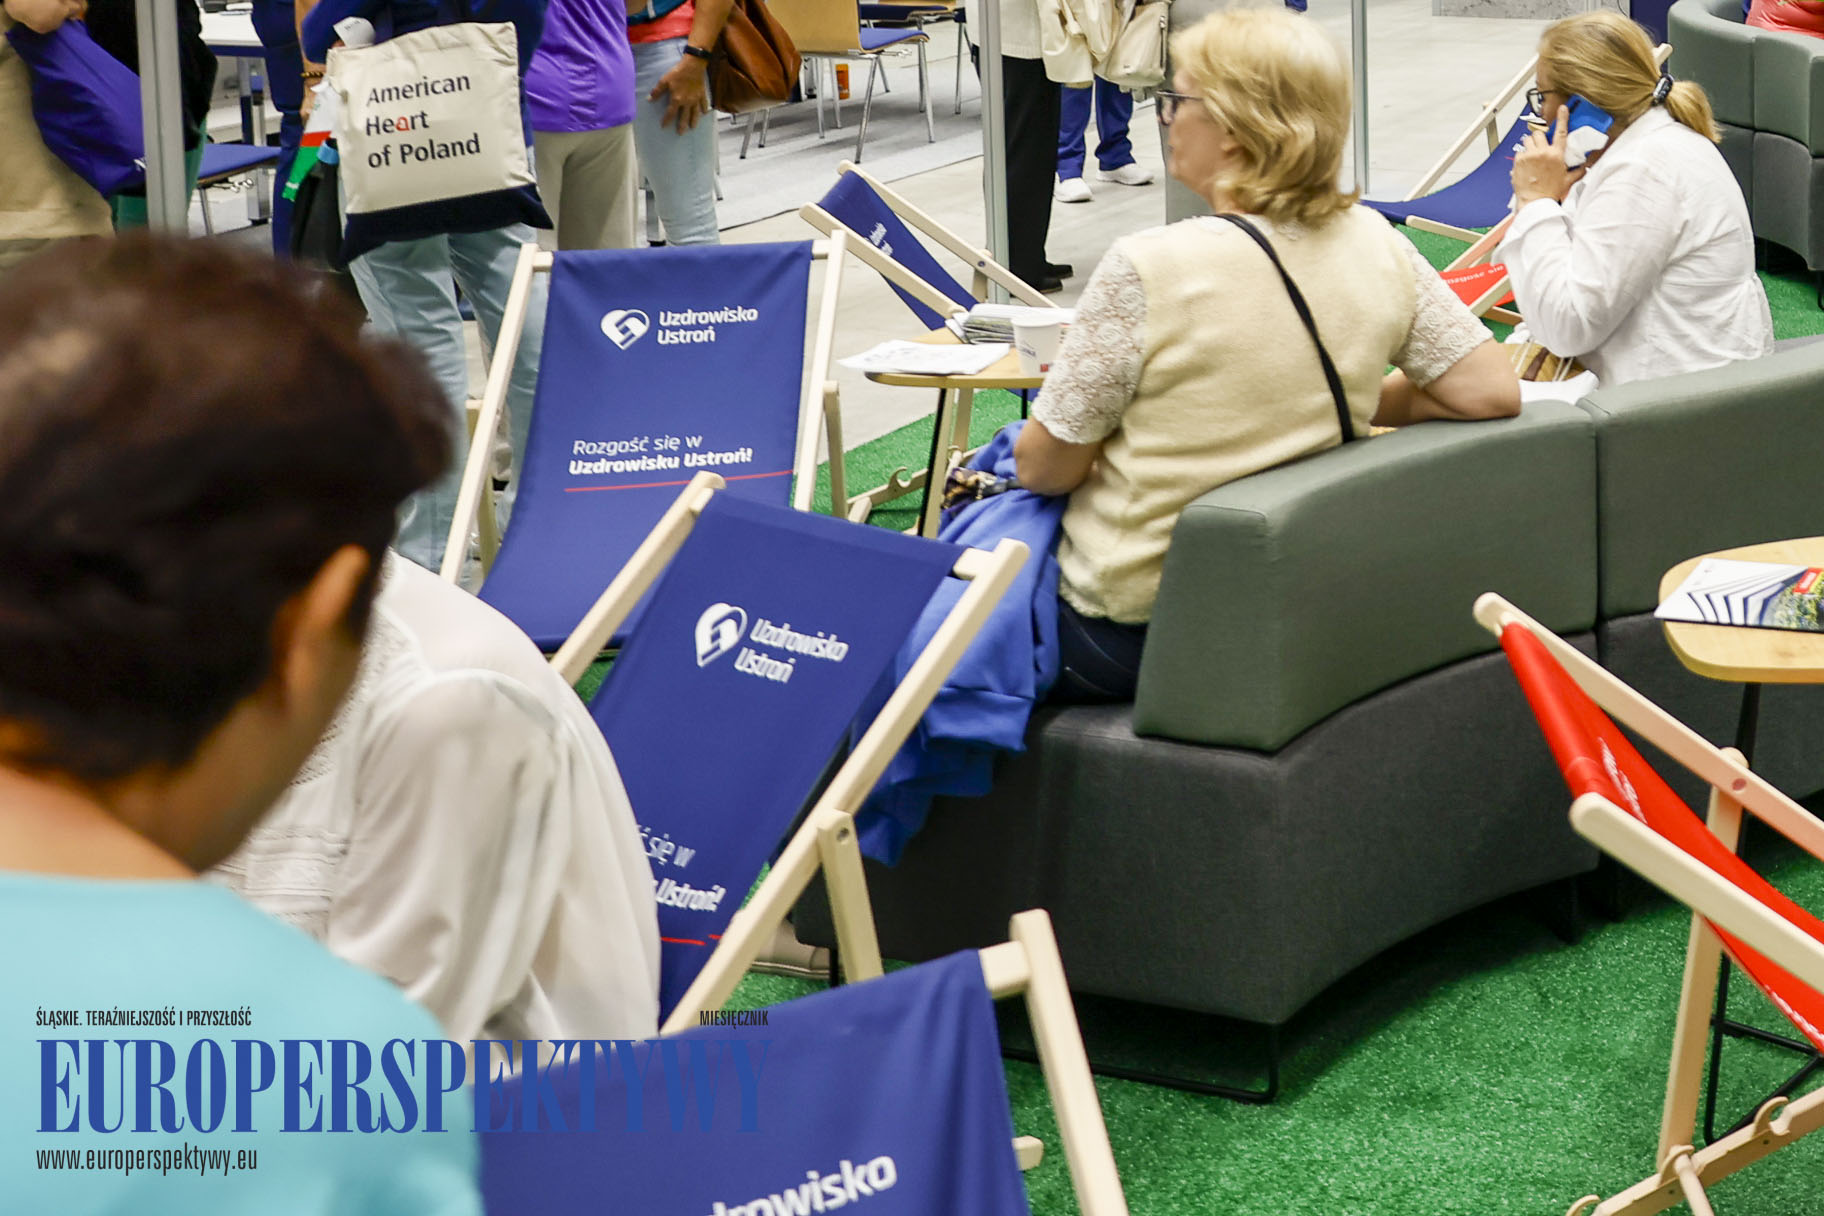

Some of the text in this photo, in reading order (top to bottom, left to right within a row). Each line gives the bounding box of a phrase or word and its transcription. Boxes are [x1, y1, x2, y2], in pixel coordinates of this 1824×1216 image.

[366, 75, 471, 107] American
[365, 111, 430, 136] Heart
[368, 133, 481, 168] of Poland
[659, 305, 759, 327] Uzdrowisko
[657, 325, 716, 345] Ustroń
[572, 434, 703, 457] Rozgość się w
[568, 447, 754, 476] Uzdrowisku Ustroń!
[749, 617, 849, 663] Uzdrowisko
